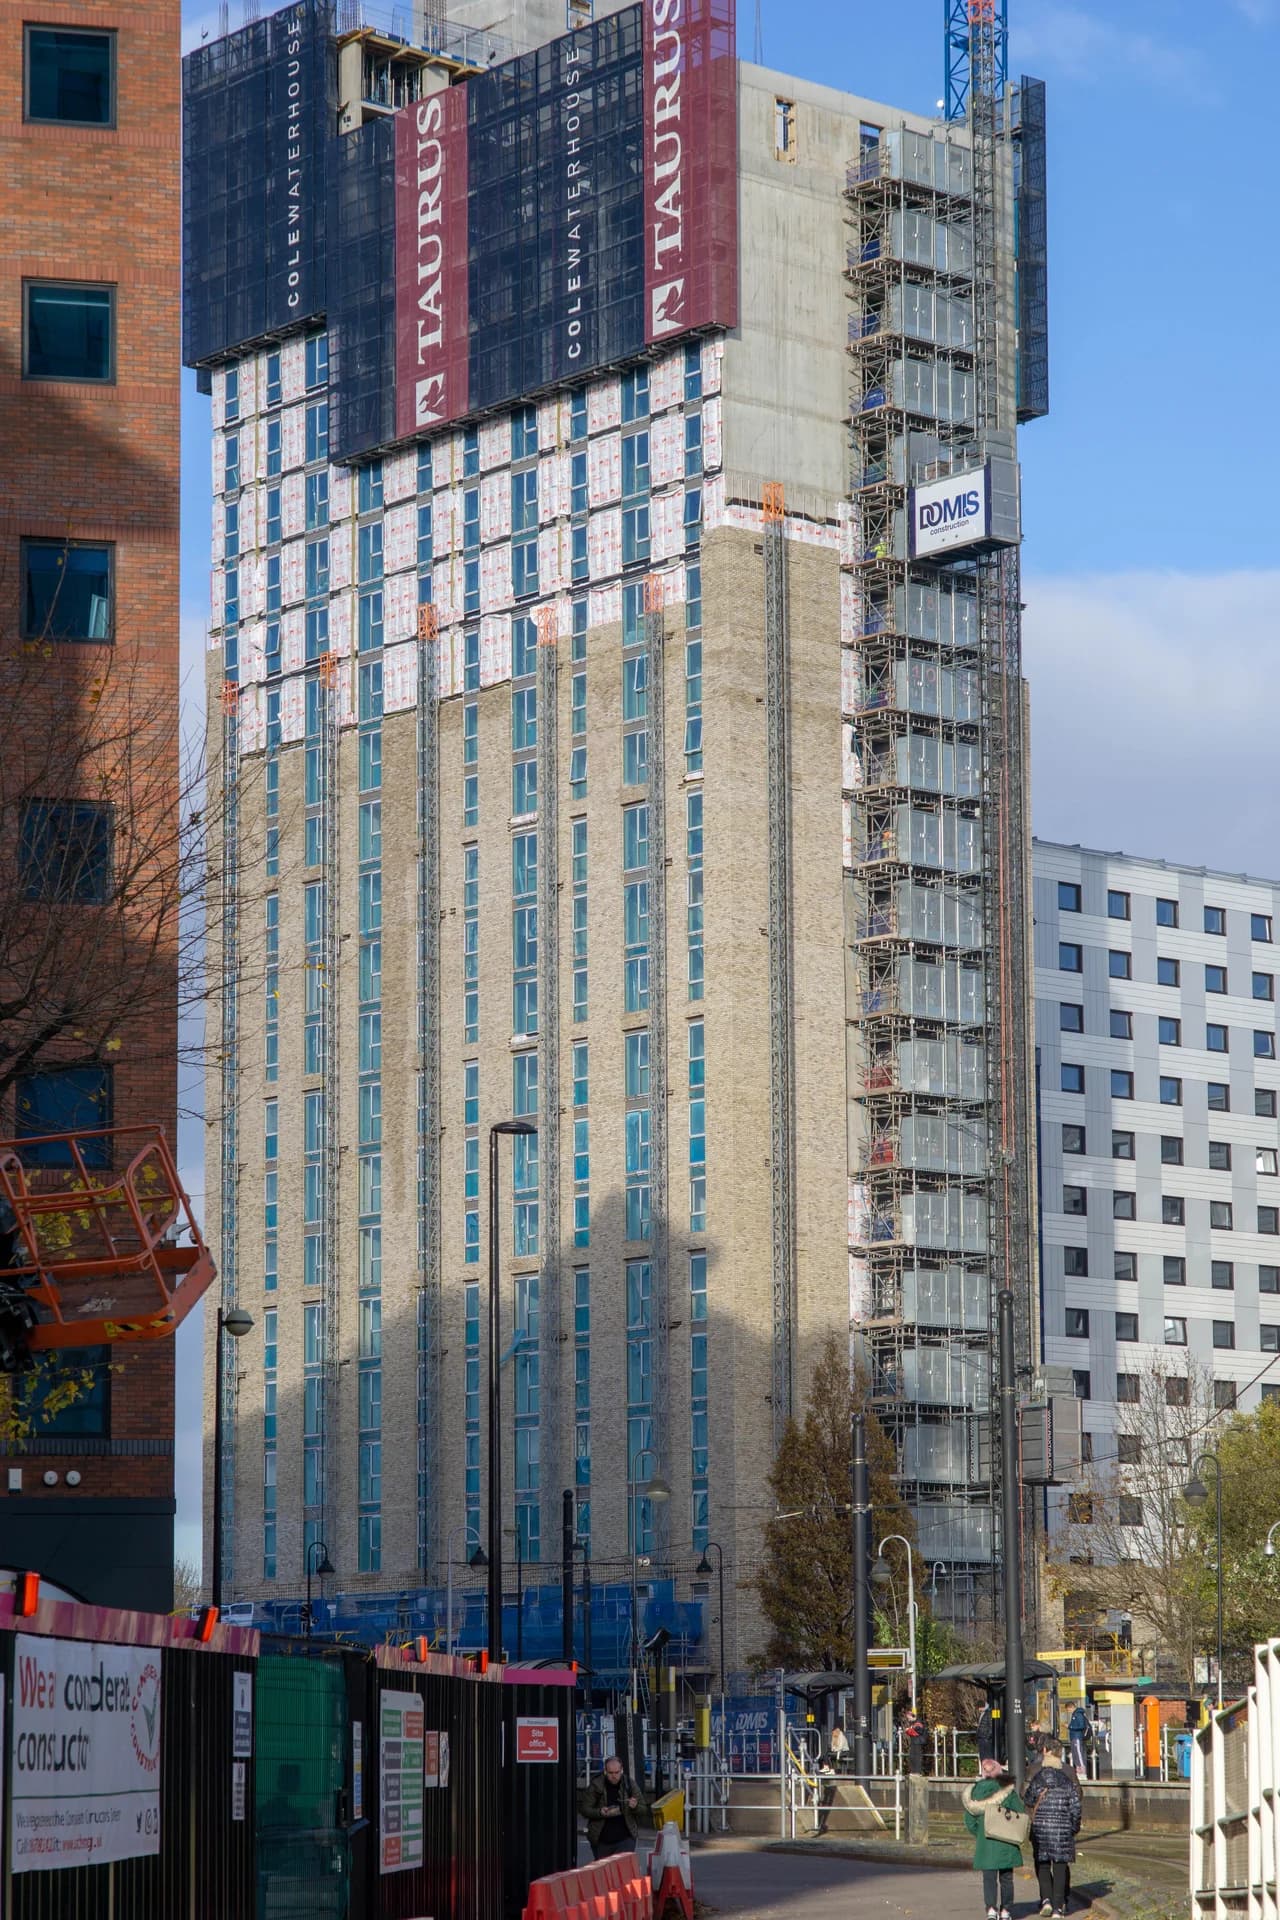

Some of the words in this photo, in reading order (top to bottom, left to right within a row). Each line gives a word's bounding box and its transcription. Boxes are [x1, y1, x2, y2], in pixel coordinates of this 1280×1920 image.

[653, 0, 681, 270] TAURUS
[417, 98, 442, 364] TAURUS
[919, 490, 980, 530] DOMIS
[929, 519, 970, 535] construction
[19, 1655, 46, 1709] We
[528, 1739, 546, 1748] office
[531, 1729, 544, 1738] Site
